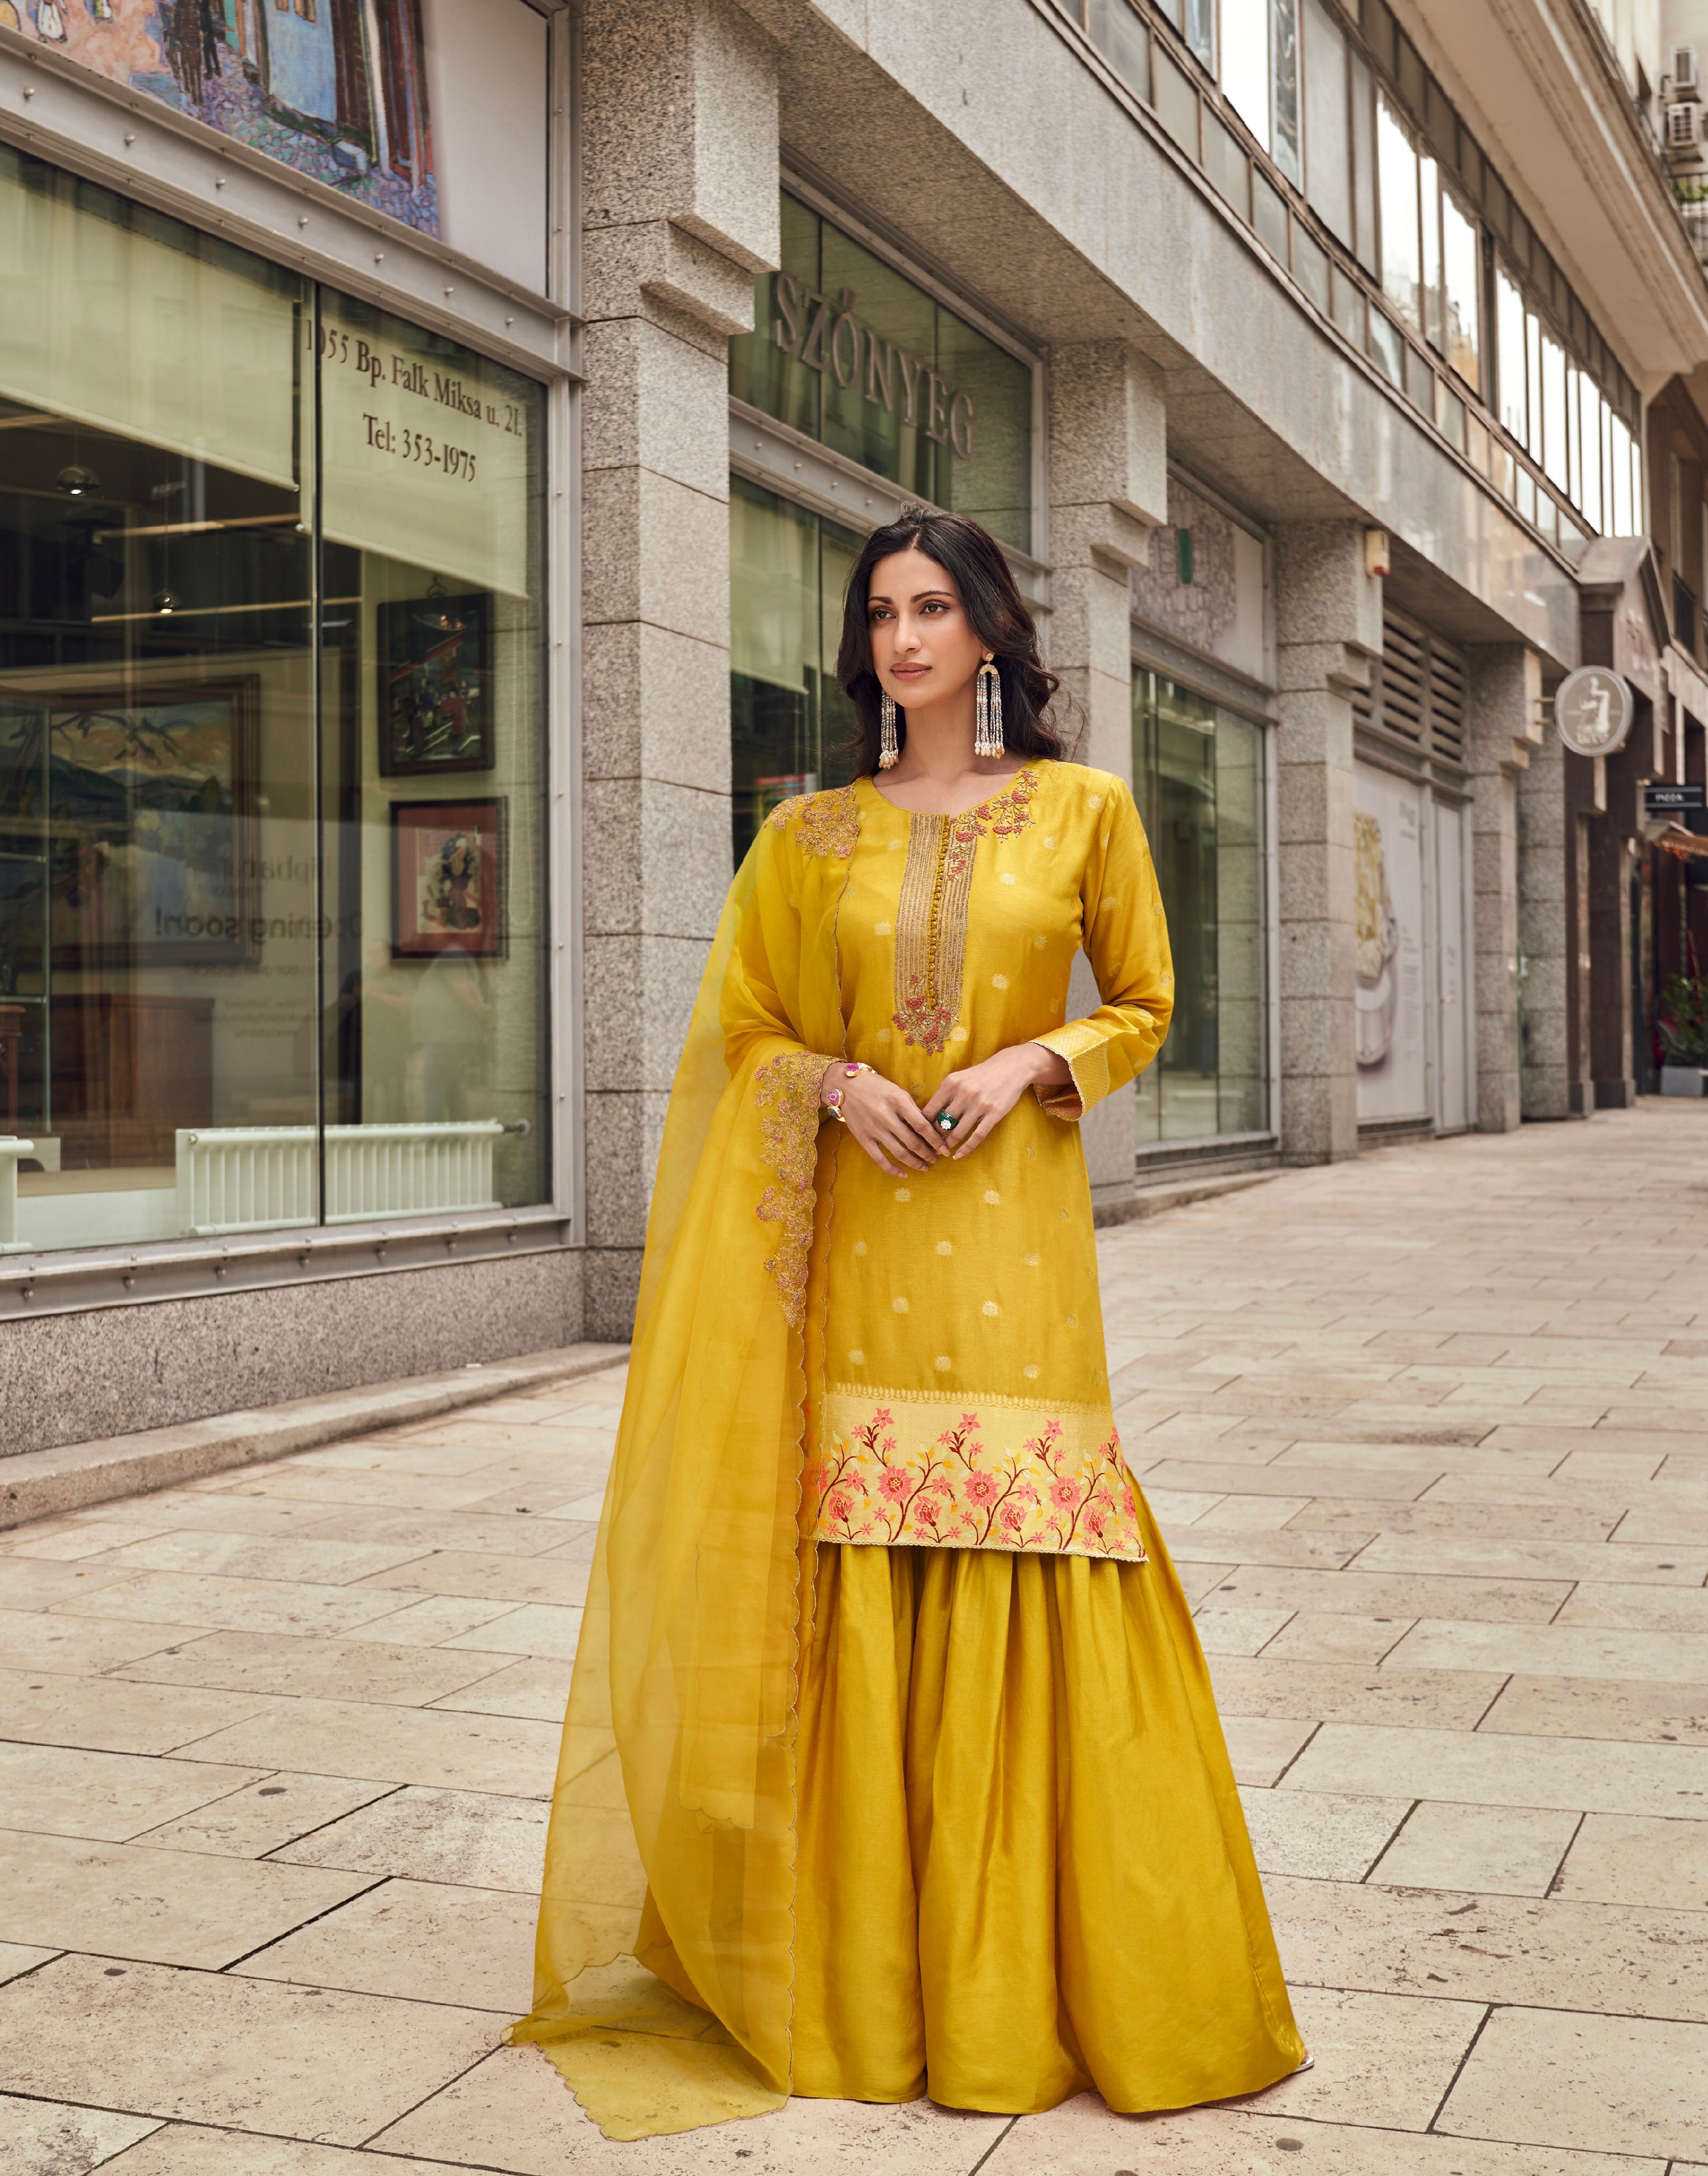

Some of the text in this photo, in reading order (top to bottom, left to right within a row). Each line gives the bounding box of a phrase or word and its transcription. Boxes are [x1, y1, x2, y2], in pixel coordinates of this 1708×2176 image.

[355, 339, 386, 387] Bp.
[391, 355, 429, 397] Falk
[434, 372, 482, 420] Miksa
[486, 404, 499, 428] u.
[363, 414, 477, 482] Tel: 353-1975
